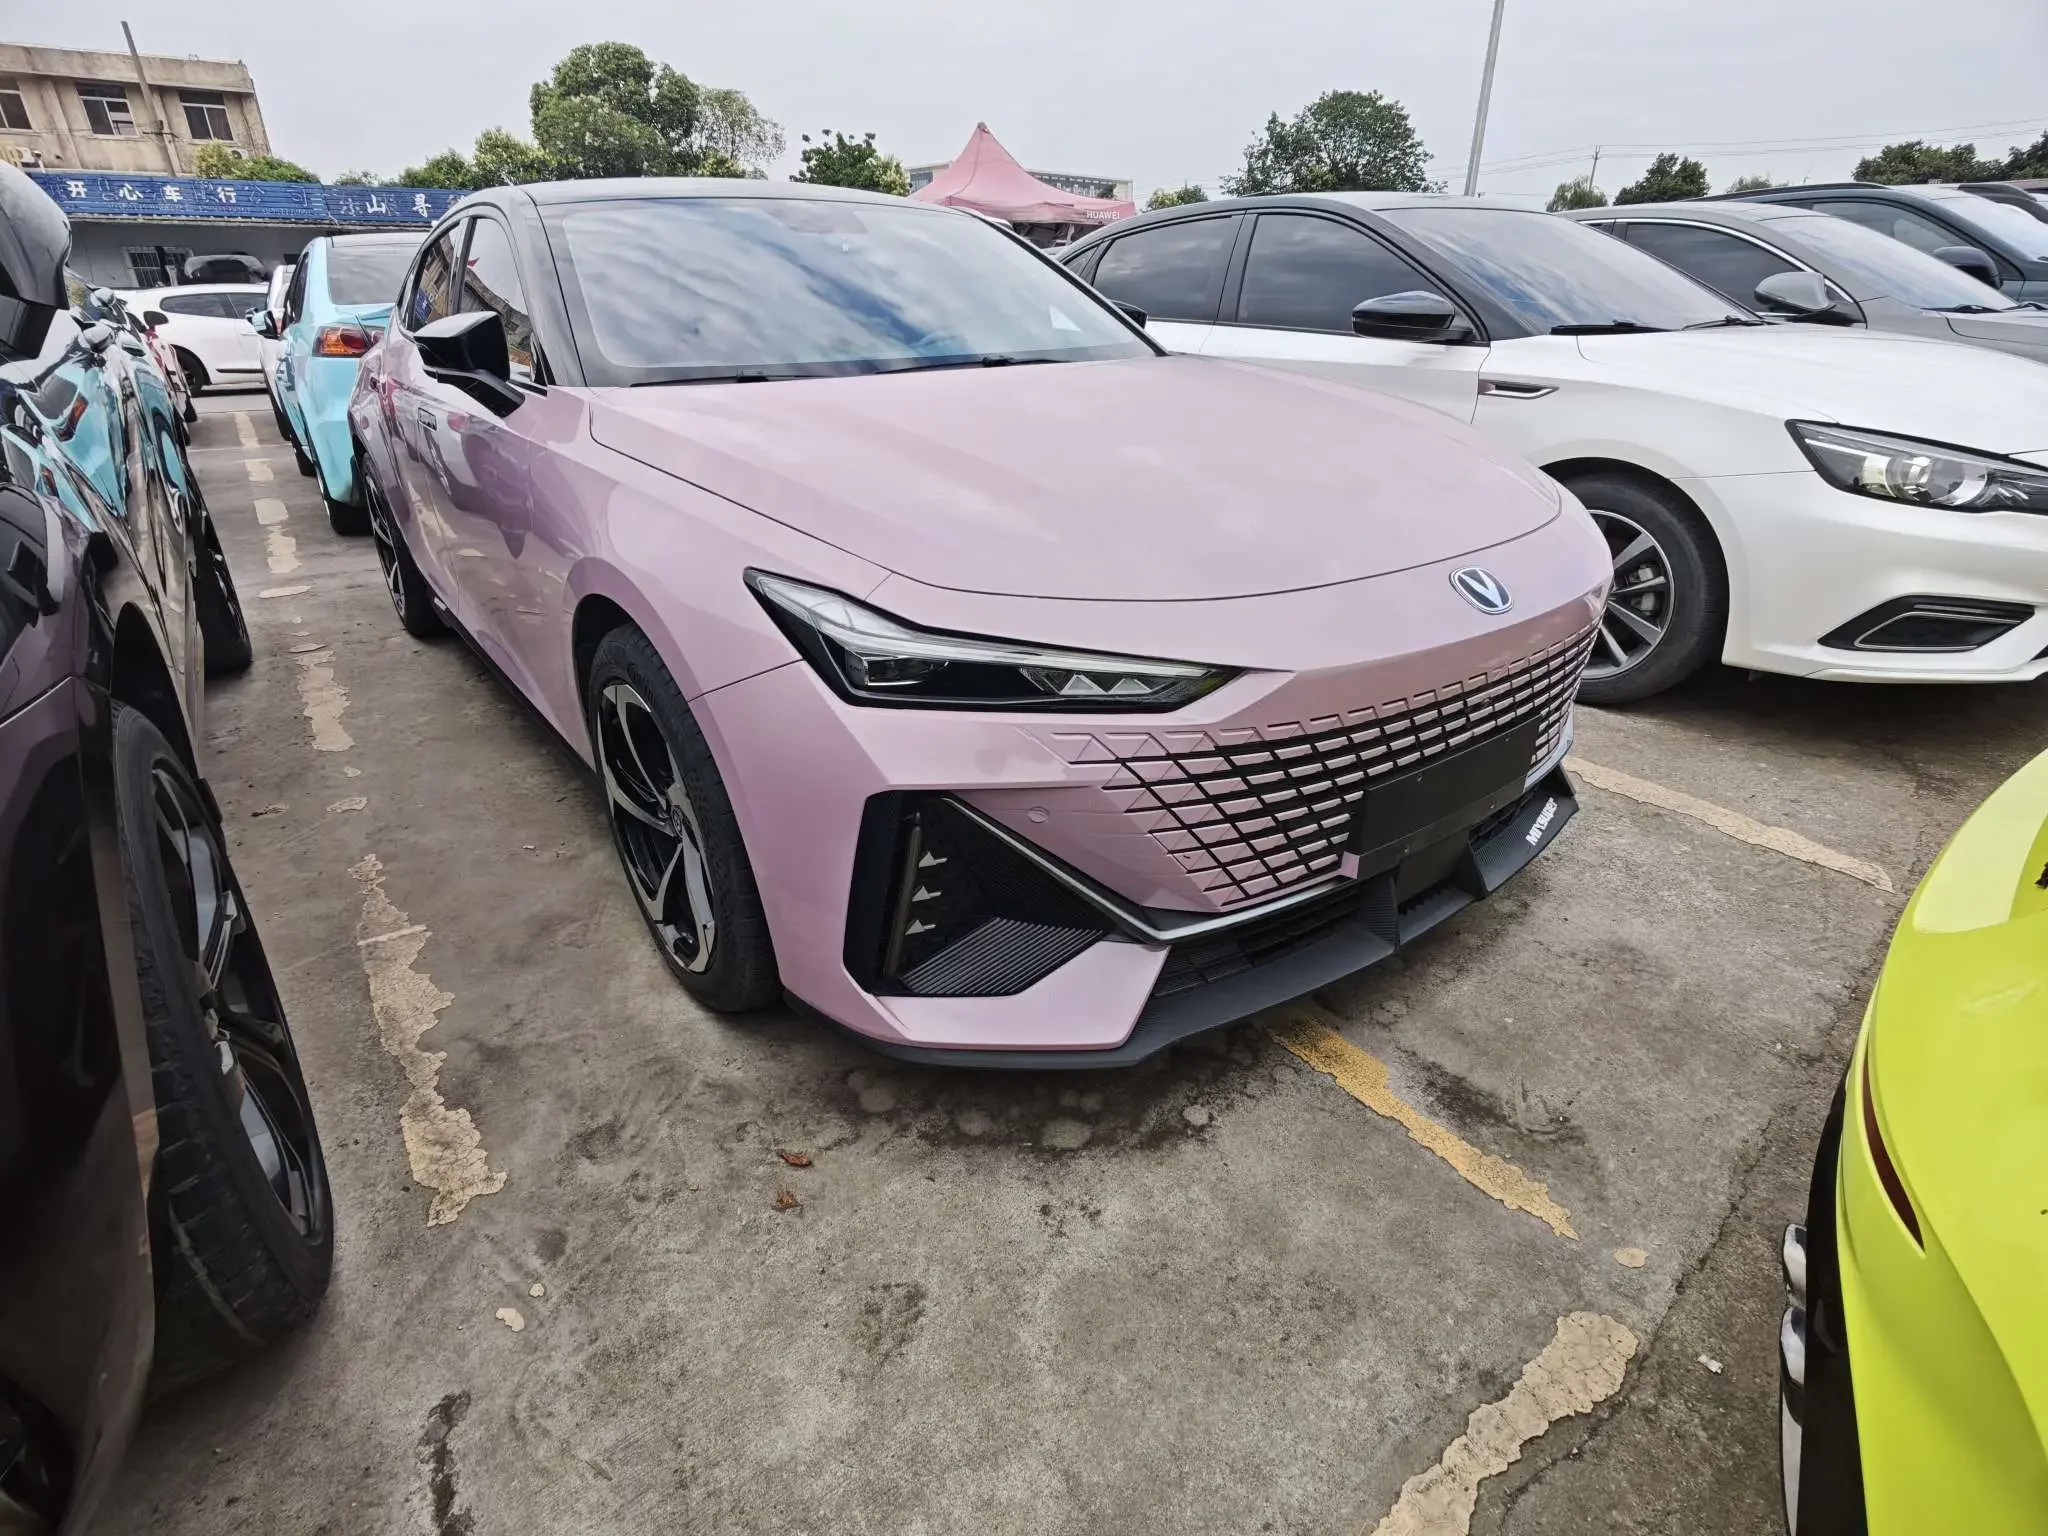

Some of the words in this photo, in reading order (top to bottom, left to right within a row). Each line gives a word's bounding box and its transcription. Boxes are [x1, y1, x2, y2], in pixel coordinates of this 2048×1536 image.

[66, 180, 237, 203] 开心车行
[1086, 210, 1120, 220] HUAWEI
